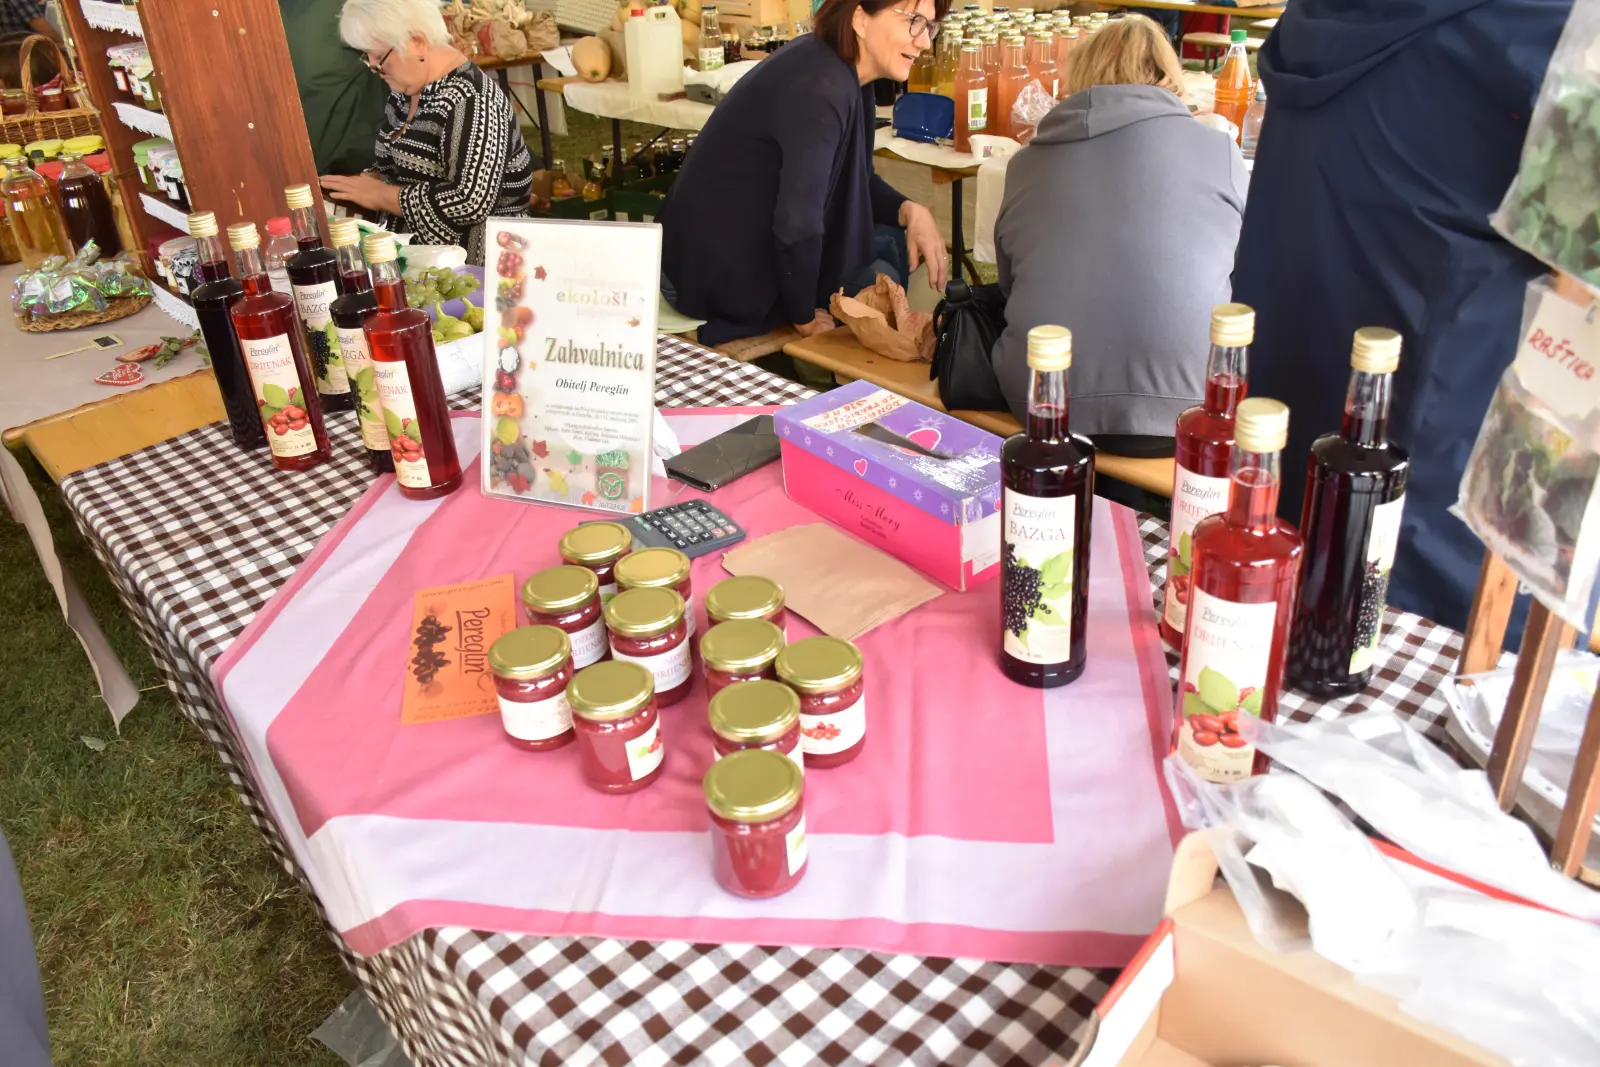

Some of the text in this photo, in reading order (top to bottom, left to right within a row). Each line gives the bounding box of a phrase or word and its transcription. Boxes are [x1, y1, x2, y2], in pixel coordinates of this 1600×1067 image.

[300, 302, 331, 313] BAZG
[250, 356, 292, 370] DRIJENAK
[544, 336, 645, 371] Zahvalnica
[1528, 328, 1594, 381] RAŠTIKA
[555, 377, 629, 396] Obitelj Pereglin
[1182, 479, 1221, 499] Pereglin
[1010, 520, 1066, 541] BAZGA
